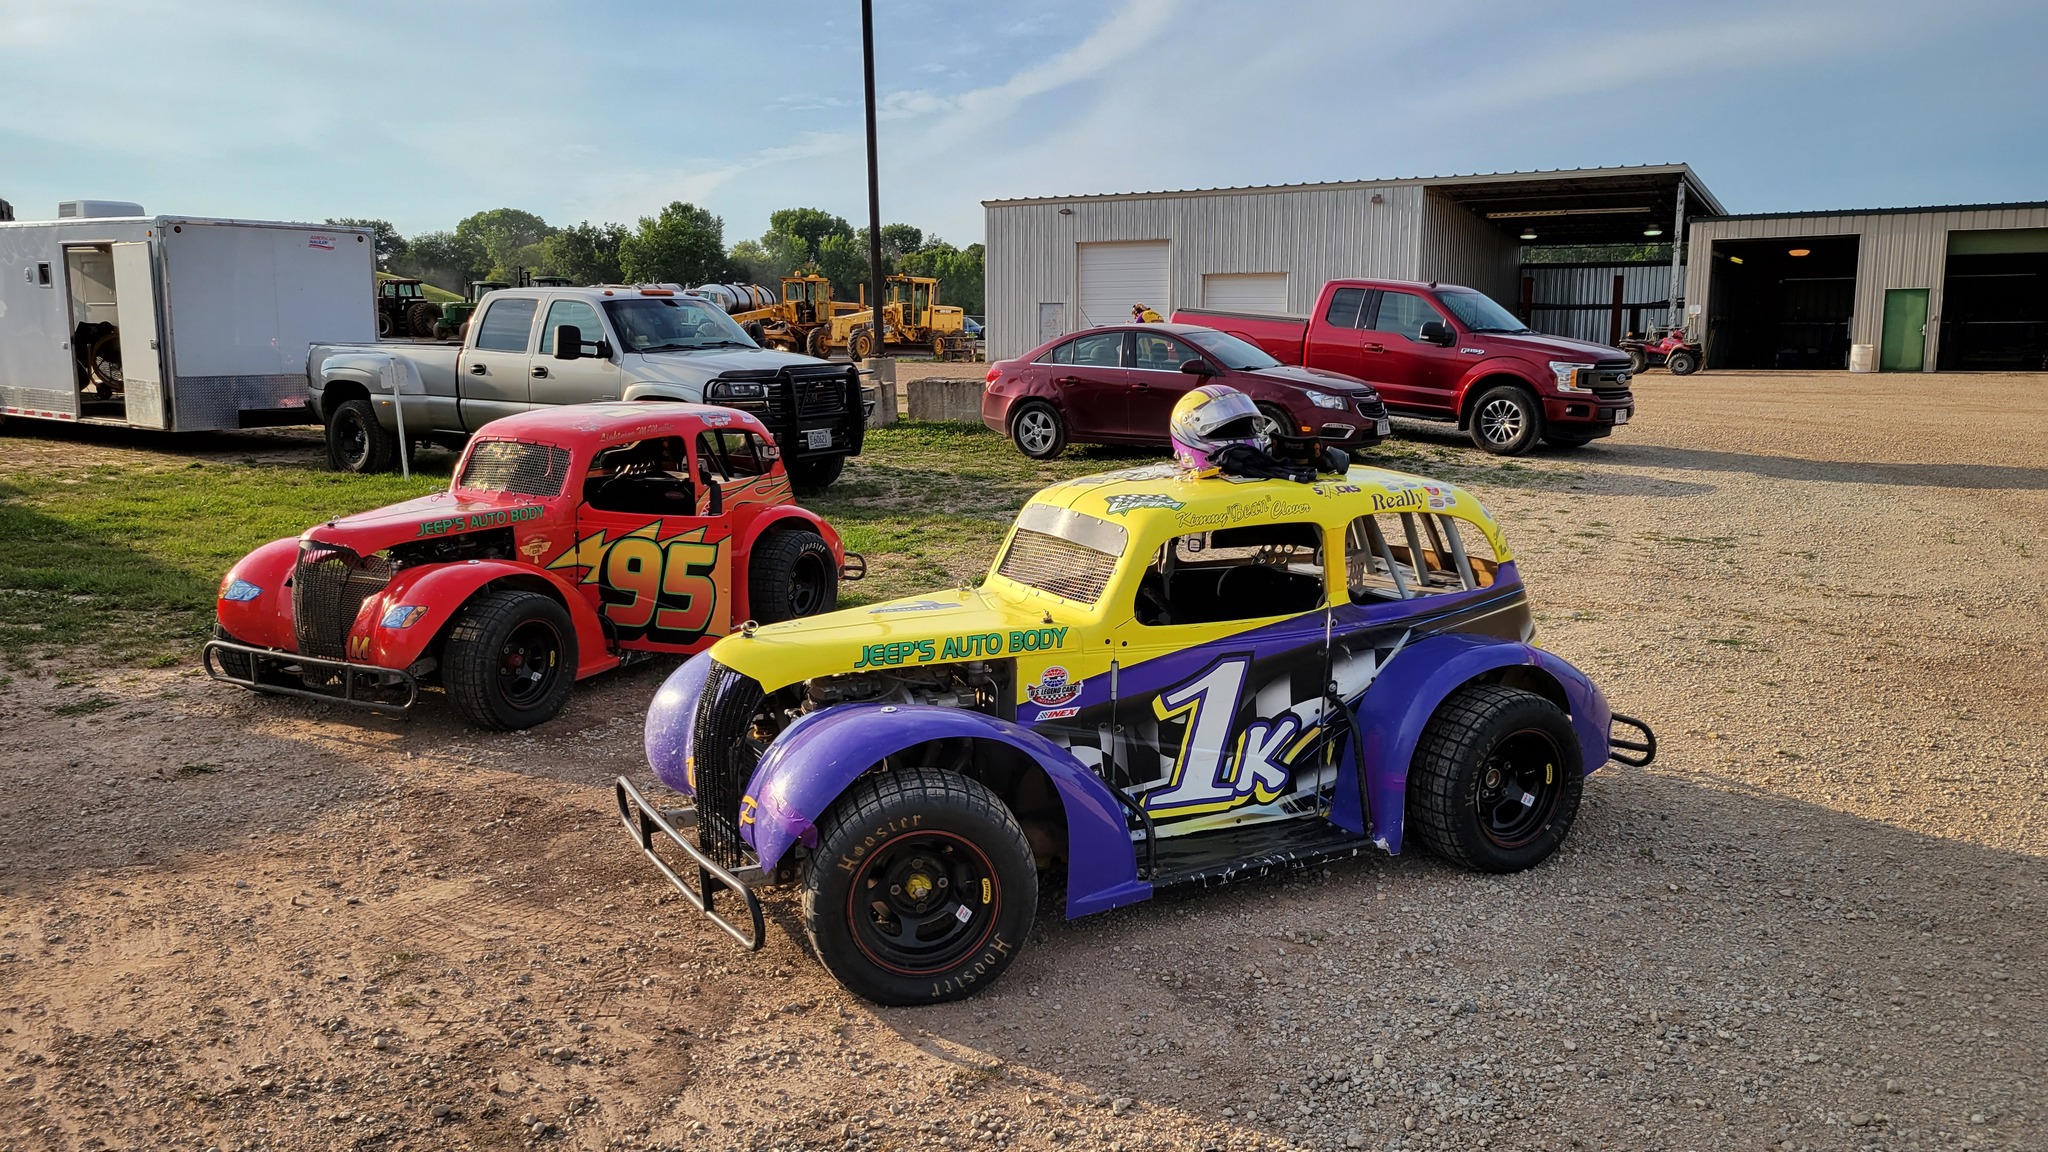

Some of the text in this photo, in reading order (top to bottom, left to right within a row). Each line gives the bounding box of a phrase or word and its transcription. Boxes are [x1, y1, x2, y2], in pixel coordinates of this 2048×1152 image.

[1175, 511, 1229, 528] Kimmy
[1270, 500, 1311, 519] Clover
[1371, 489, 1424, 511] Really
[416, 505, 545, 537] JEEP'S AUTO BODY
[603, 536, 718, 634] 95
[350, 635, 370, 660] M
[854, 627, 1069, 668] JEEP'S AUTO BODY
[1041, 687, 1061, 695] LEGEND
[1062, 685, 1077, 693] CARS
[1047, 708, 1076, 719] INEX
[837, 813, 922, 874] Hoosier
[931, 932, 1013, 998] Hoosier
